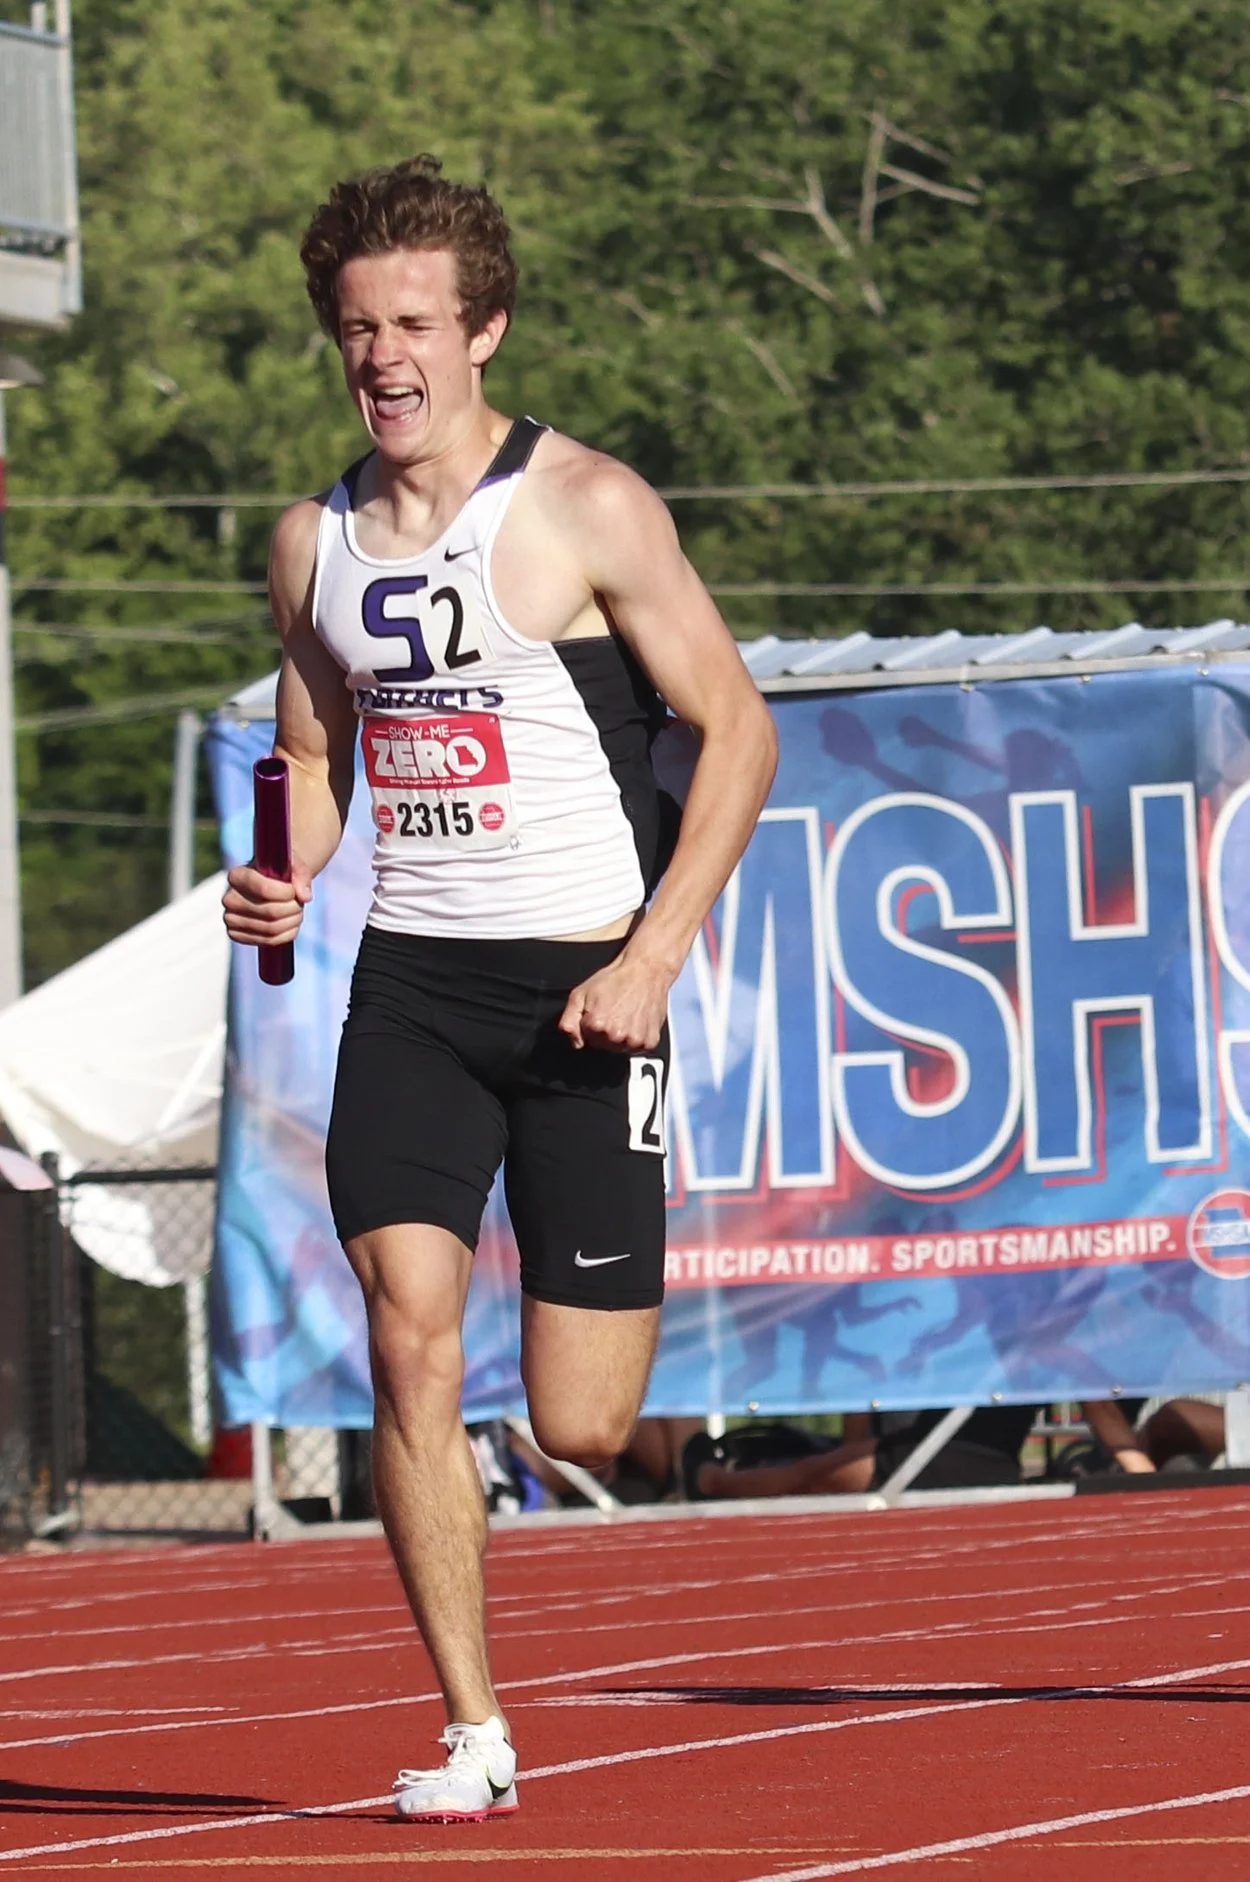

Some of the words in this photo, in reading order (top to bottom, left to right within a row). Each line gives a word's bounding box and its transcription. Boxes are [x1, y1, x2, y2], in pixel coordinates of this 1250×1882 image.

[362, 575, 435, 682] S
[430, 586, 482, 670] 2
[370, 735, 486, 778] ZERO
[388, 724, 450, 740] SHOW-ME
[397, 801, 474, 838] 2315
[640, 1062, 660, 1147] 2
[665, 1242, 881, 1281] RTICIPATION.
[891, 1221, 1178, 1272] SPORTSMANSHIP.
